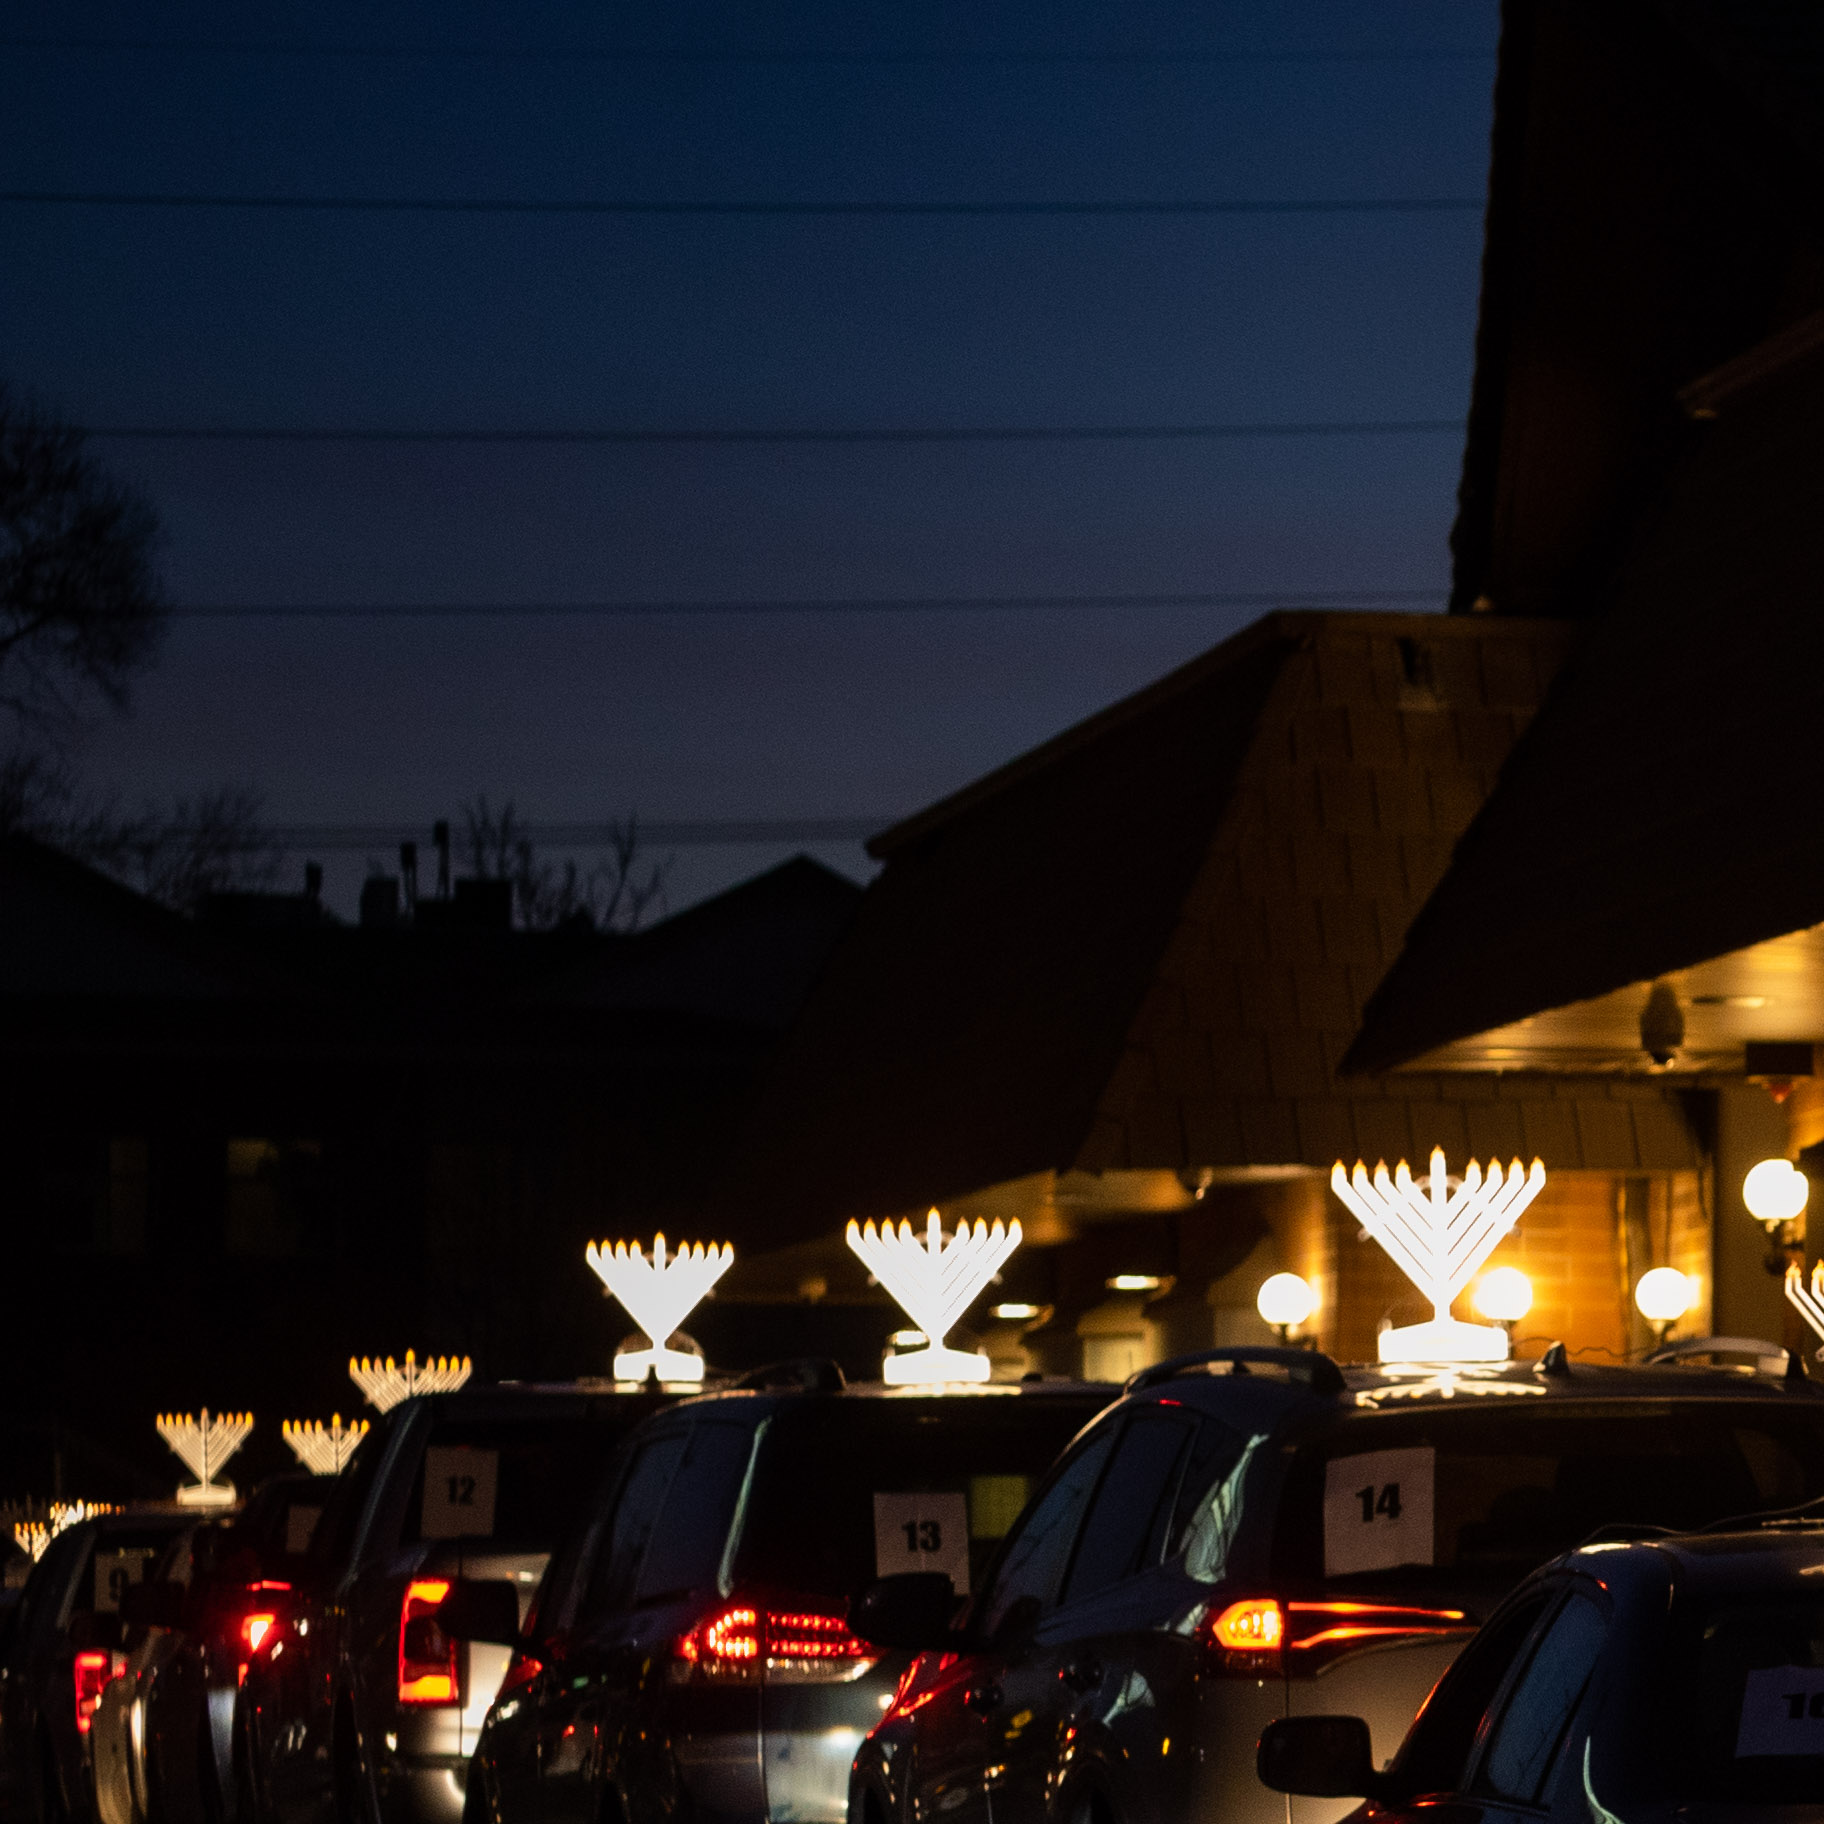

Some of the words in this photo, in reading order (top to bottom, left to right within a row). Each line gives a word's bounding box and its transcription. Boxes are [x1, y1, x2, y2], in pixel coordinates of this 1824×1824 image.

[447, 1476, 476, 1505] 12
[1356, 1483, 1402, 1522] 14
[902, 1520, 942, 1552] 13
